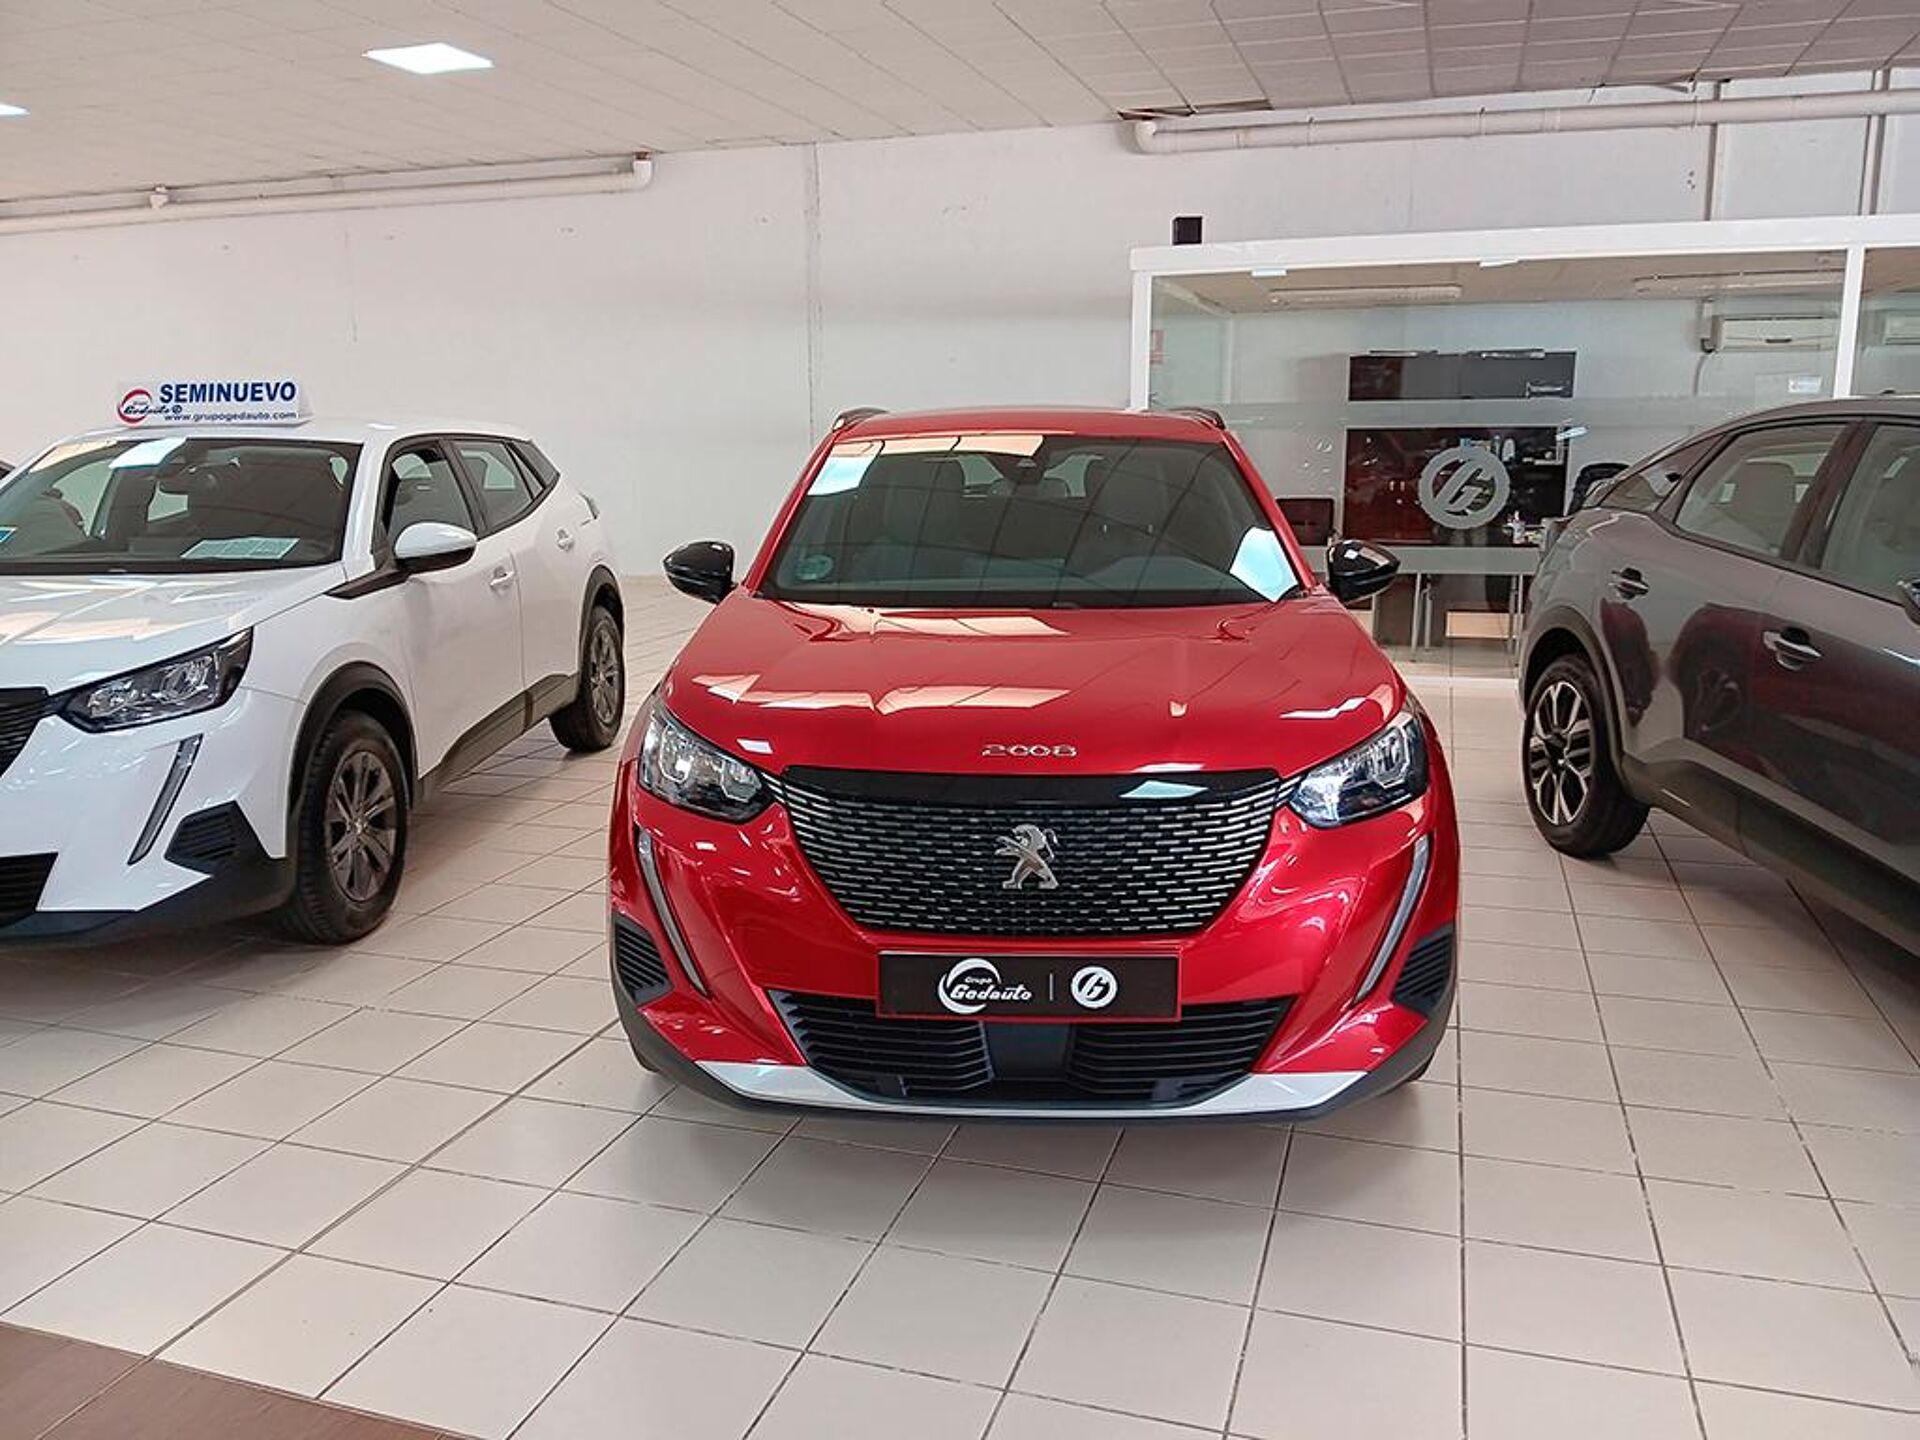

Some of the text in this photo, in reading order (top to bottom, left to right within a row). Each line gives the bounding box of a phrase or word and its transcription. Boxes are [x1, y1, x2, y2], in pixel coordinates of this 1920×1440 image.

[159, 382, 296, 403] SEMINUEVO
[164, 412, 297, 422] www.grupogedauto.com
[982, 744, 1077, 756] 2008
